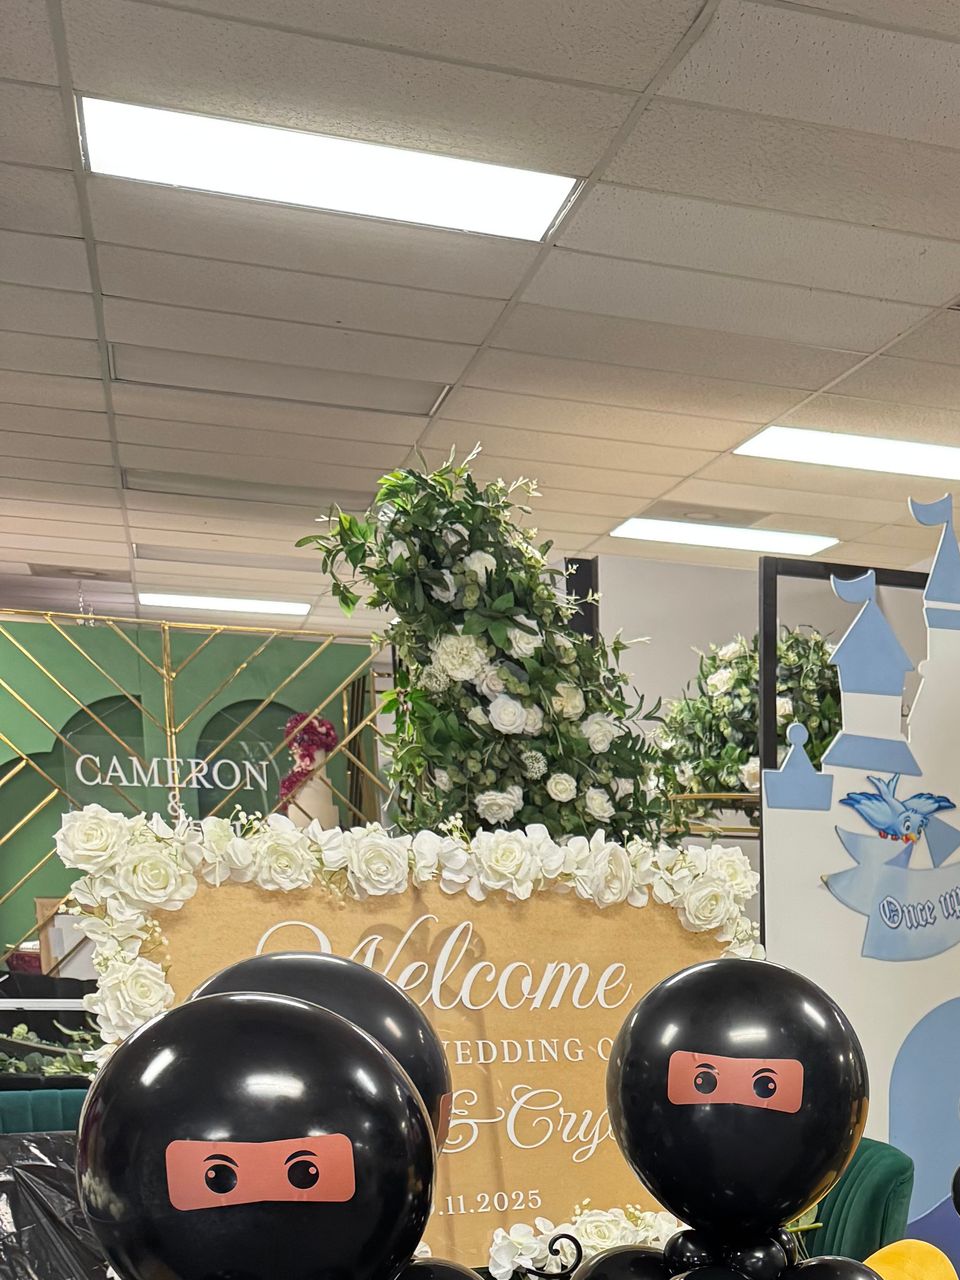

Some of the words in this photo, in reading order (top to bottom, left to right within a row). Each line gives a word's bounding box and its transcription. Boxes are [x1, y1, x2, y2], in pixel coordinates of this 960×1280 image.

[75, 754, 269, 791] CAMERON
[167, 791, 186, 817] &
[879, 895, 937, 929] Once
[441, 1089, 505, 1153] &
[437, 1189, 542, 1216] .11.2025
